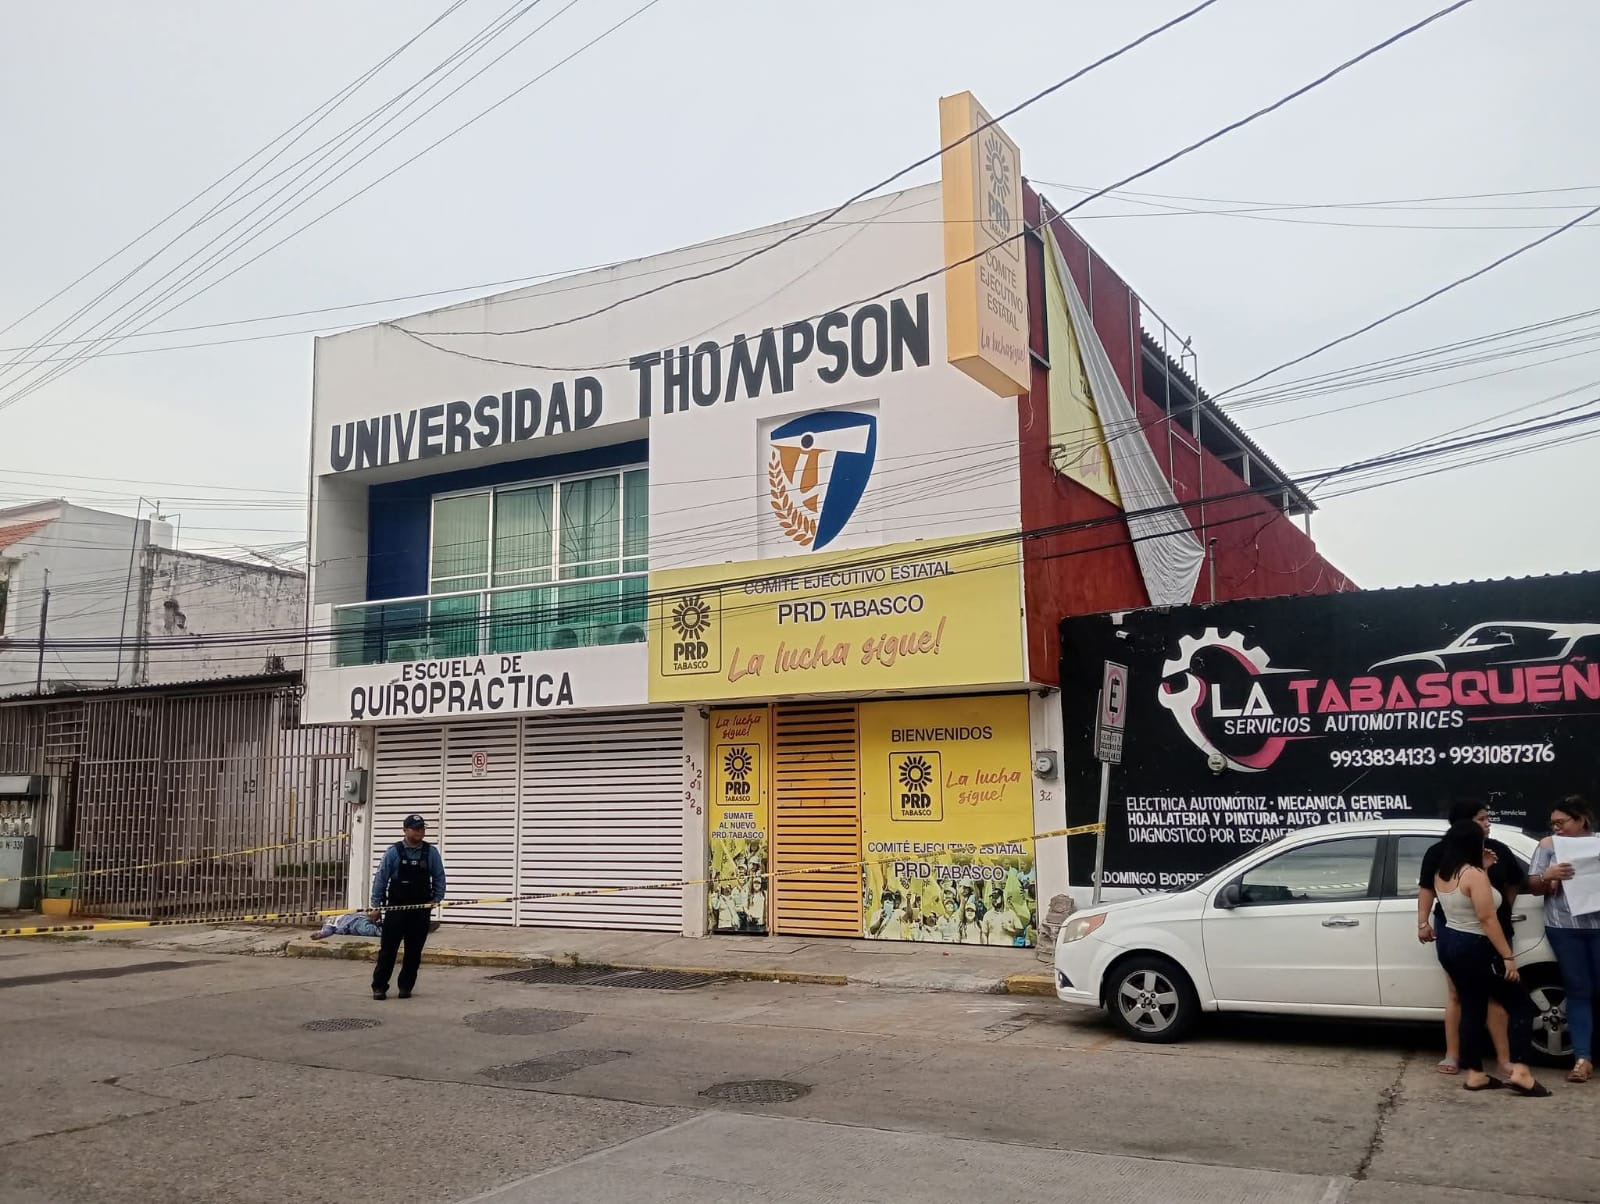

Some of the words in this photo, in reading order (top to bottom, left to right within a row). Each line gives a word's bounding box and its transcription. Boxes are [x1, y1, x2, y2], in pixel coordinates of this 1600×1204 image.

[987, 293, 1020, 331] ESTATAL
[330, 376, 603, 472] UNIVERSIDAD
[629, 292, 930, 418] THOMPSON
[804, 567, 886, 590] EJECUTIVO
[891, 560, 954, 580] ESTATAL
[778, 601, 826, 625] PRD
[831, 594, 924, 620] TABASCO
[673, 640, 708, 662] PRD
[728, 646, 764, 683] La
[774, 634, 850, 674] lucha
[861, 615, 947, 668] sigue!
[403, 658, 486, 682] ESCUELA
[500, 655, 522, 674] DE
[673, 660, 709, 671] TABASCO
[1211, 681, 1274, 718] LA
[1224, 717, 1311, 735] SERVICIOS
[1324, 710, 1464, 732] AUTOMOTRICES
[892, 726, 993, 742] BIENVENIDOS
[725, 782, 750, 795] PRD
[946, 771, 968, 789] La
[975, 768, 1022, 785] lucha
[901, 793, 931, 808] PRD
[959, 784, 1006, 806] sigue!
[1126, 796, 1187, 811] ELECTRICA
[1190, 796, 1267, 811] AUTOMOTRIZ
[1277, 795, 1347, 810] MECANICA
[1351, 795, 1412, 810] GENERAL
[1128, 812, 1211, 826] HOJALATERIA
[1213, 812, 1221, 826] Y
[1286, 811, 1322, 825] AUTO
[728, 831, 764, 839] TABASCO
[1129, 827, 1207, 843] DIAGNOSTICO
[1209, 827, 1235, 843] POR
[868, 840, 909, 853] COMITÉ
[894, 862, 931, 878] PRD
[934, 865, 1004, 880] TABASCO
